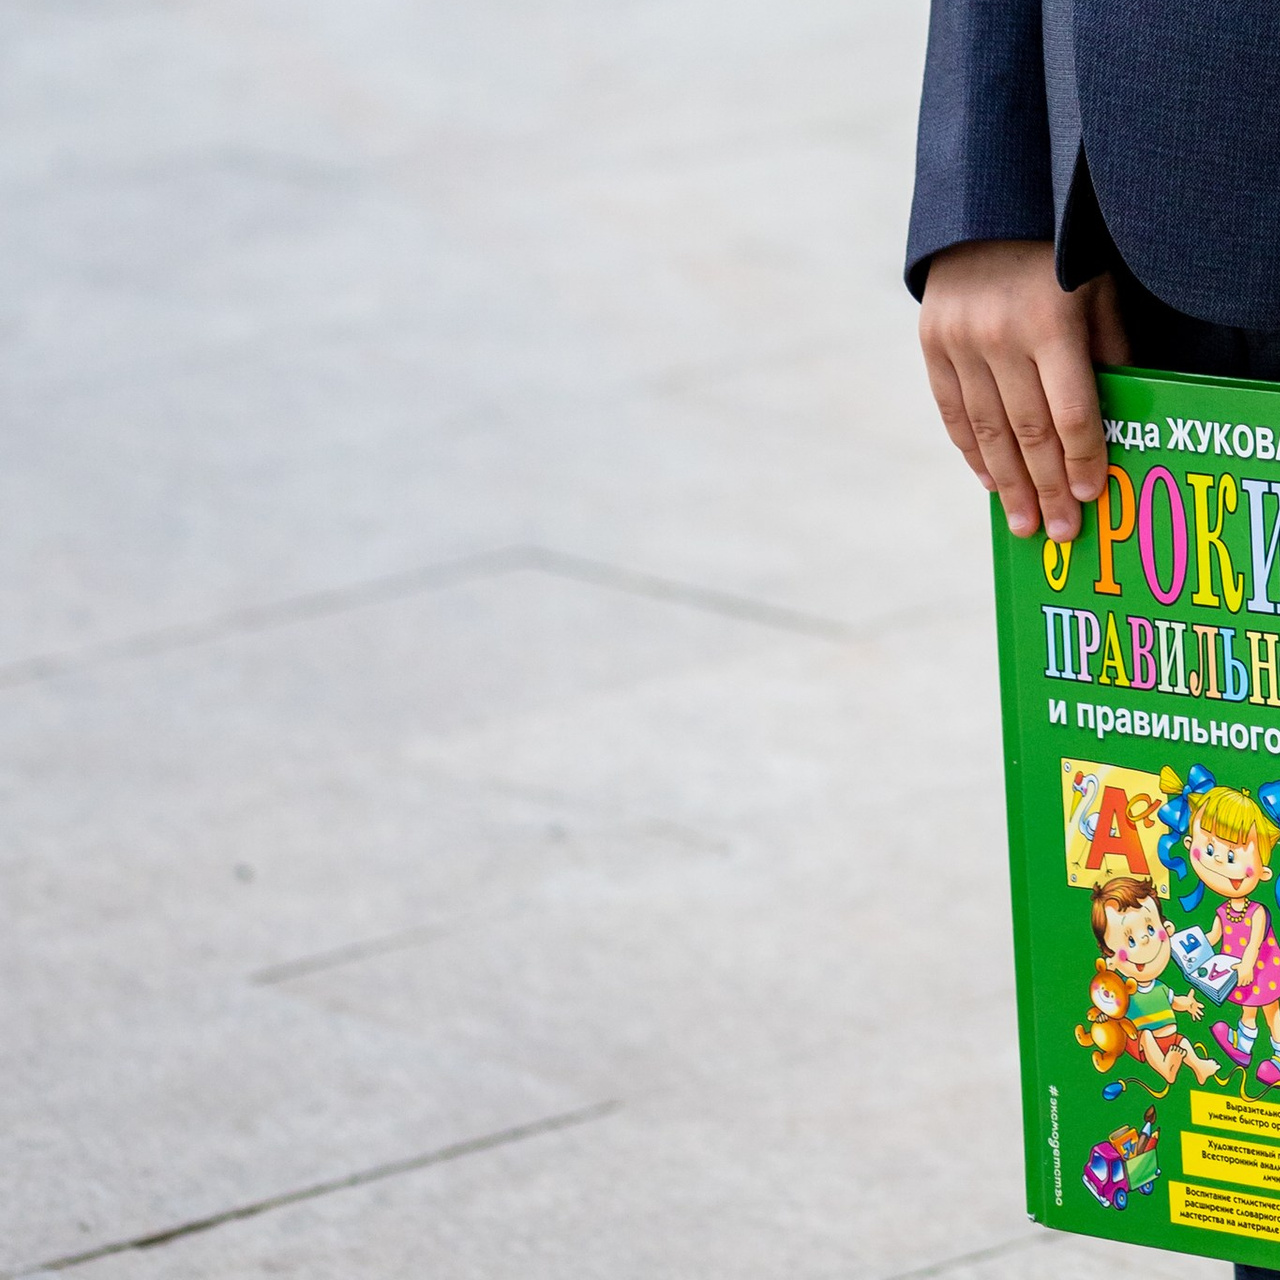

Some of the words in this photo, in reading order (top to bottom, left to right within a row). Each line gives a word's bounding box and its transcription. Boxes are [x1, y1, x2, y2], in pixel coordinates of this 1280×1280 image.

[1103, 419, 1160, 452] жда
[1049, 699, 1067, 725] и
[1208, 1112, 1237, 1123] умение
[1239, 1115, 1269, 1128] быстро
[1048, 1084, 1063, 1207] #эксмодетство
[1208, 1140, 1276, 1158] Художественный
[1202, 1151, 1258, 1168] Всесторонний
[1186, 1187, 1232, 1203] Воспитание
[1184, 1200, 1234, 1215] расширение
[1180, 1211, 1224, 1226] мастерства
[1238, 1220, 1280, 1234] материале
